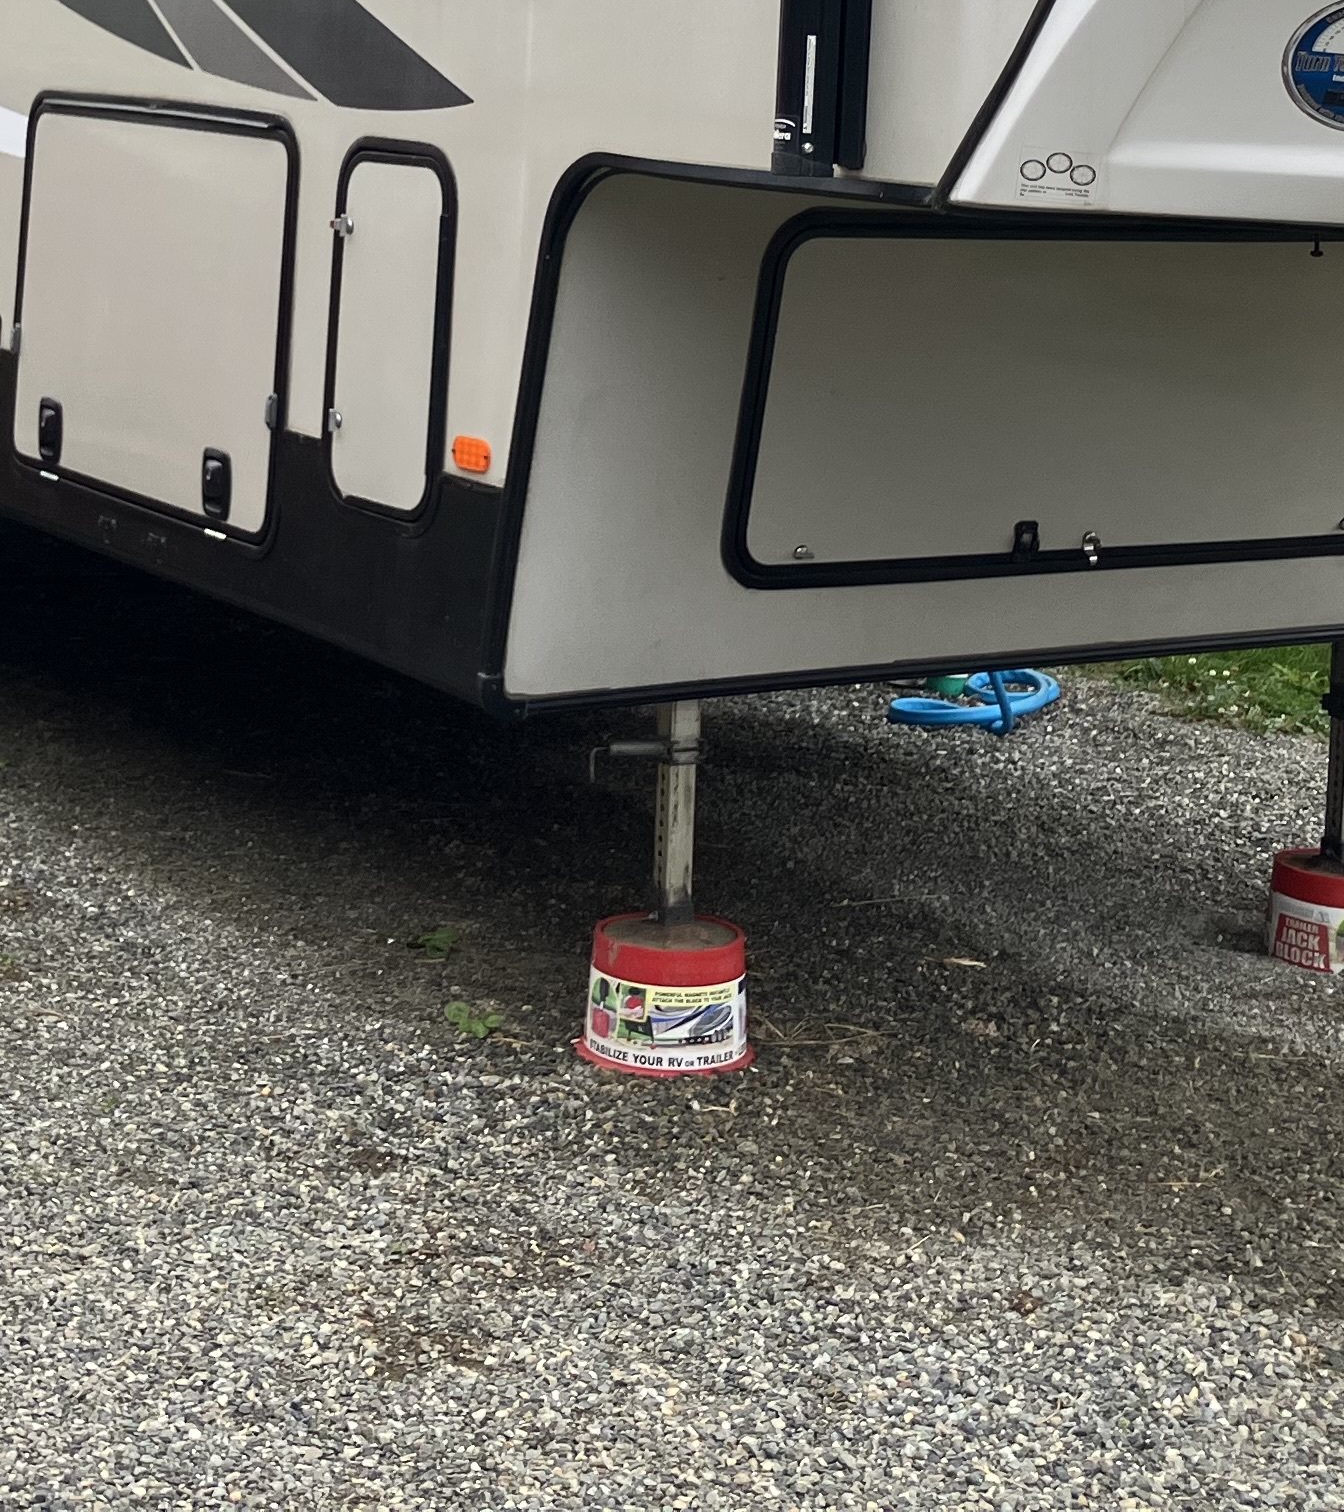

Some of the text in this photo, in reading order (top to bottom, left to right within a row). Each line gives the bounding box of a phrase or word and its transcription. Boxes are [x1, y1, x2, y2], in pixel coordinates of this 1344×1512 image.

[1295, 51, 1331, 73] Turn
[1281, 926, 1321, 951] JACK
[1275, 941, 1327, 970] BLOCK
[589, 1038, 629, 1062] STABILIZE
[632, 1053, 663, 1067] YOUR
[668, 1057, 684, 1068] RV
[697, 1050, 733, 1067] TRAILER
